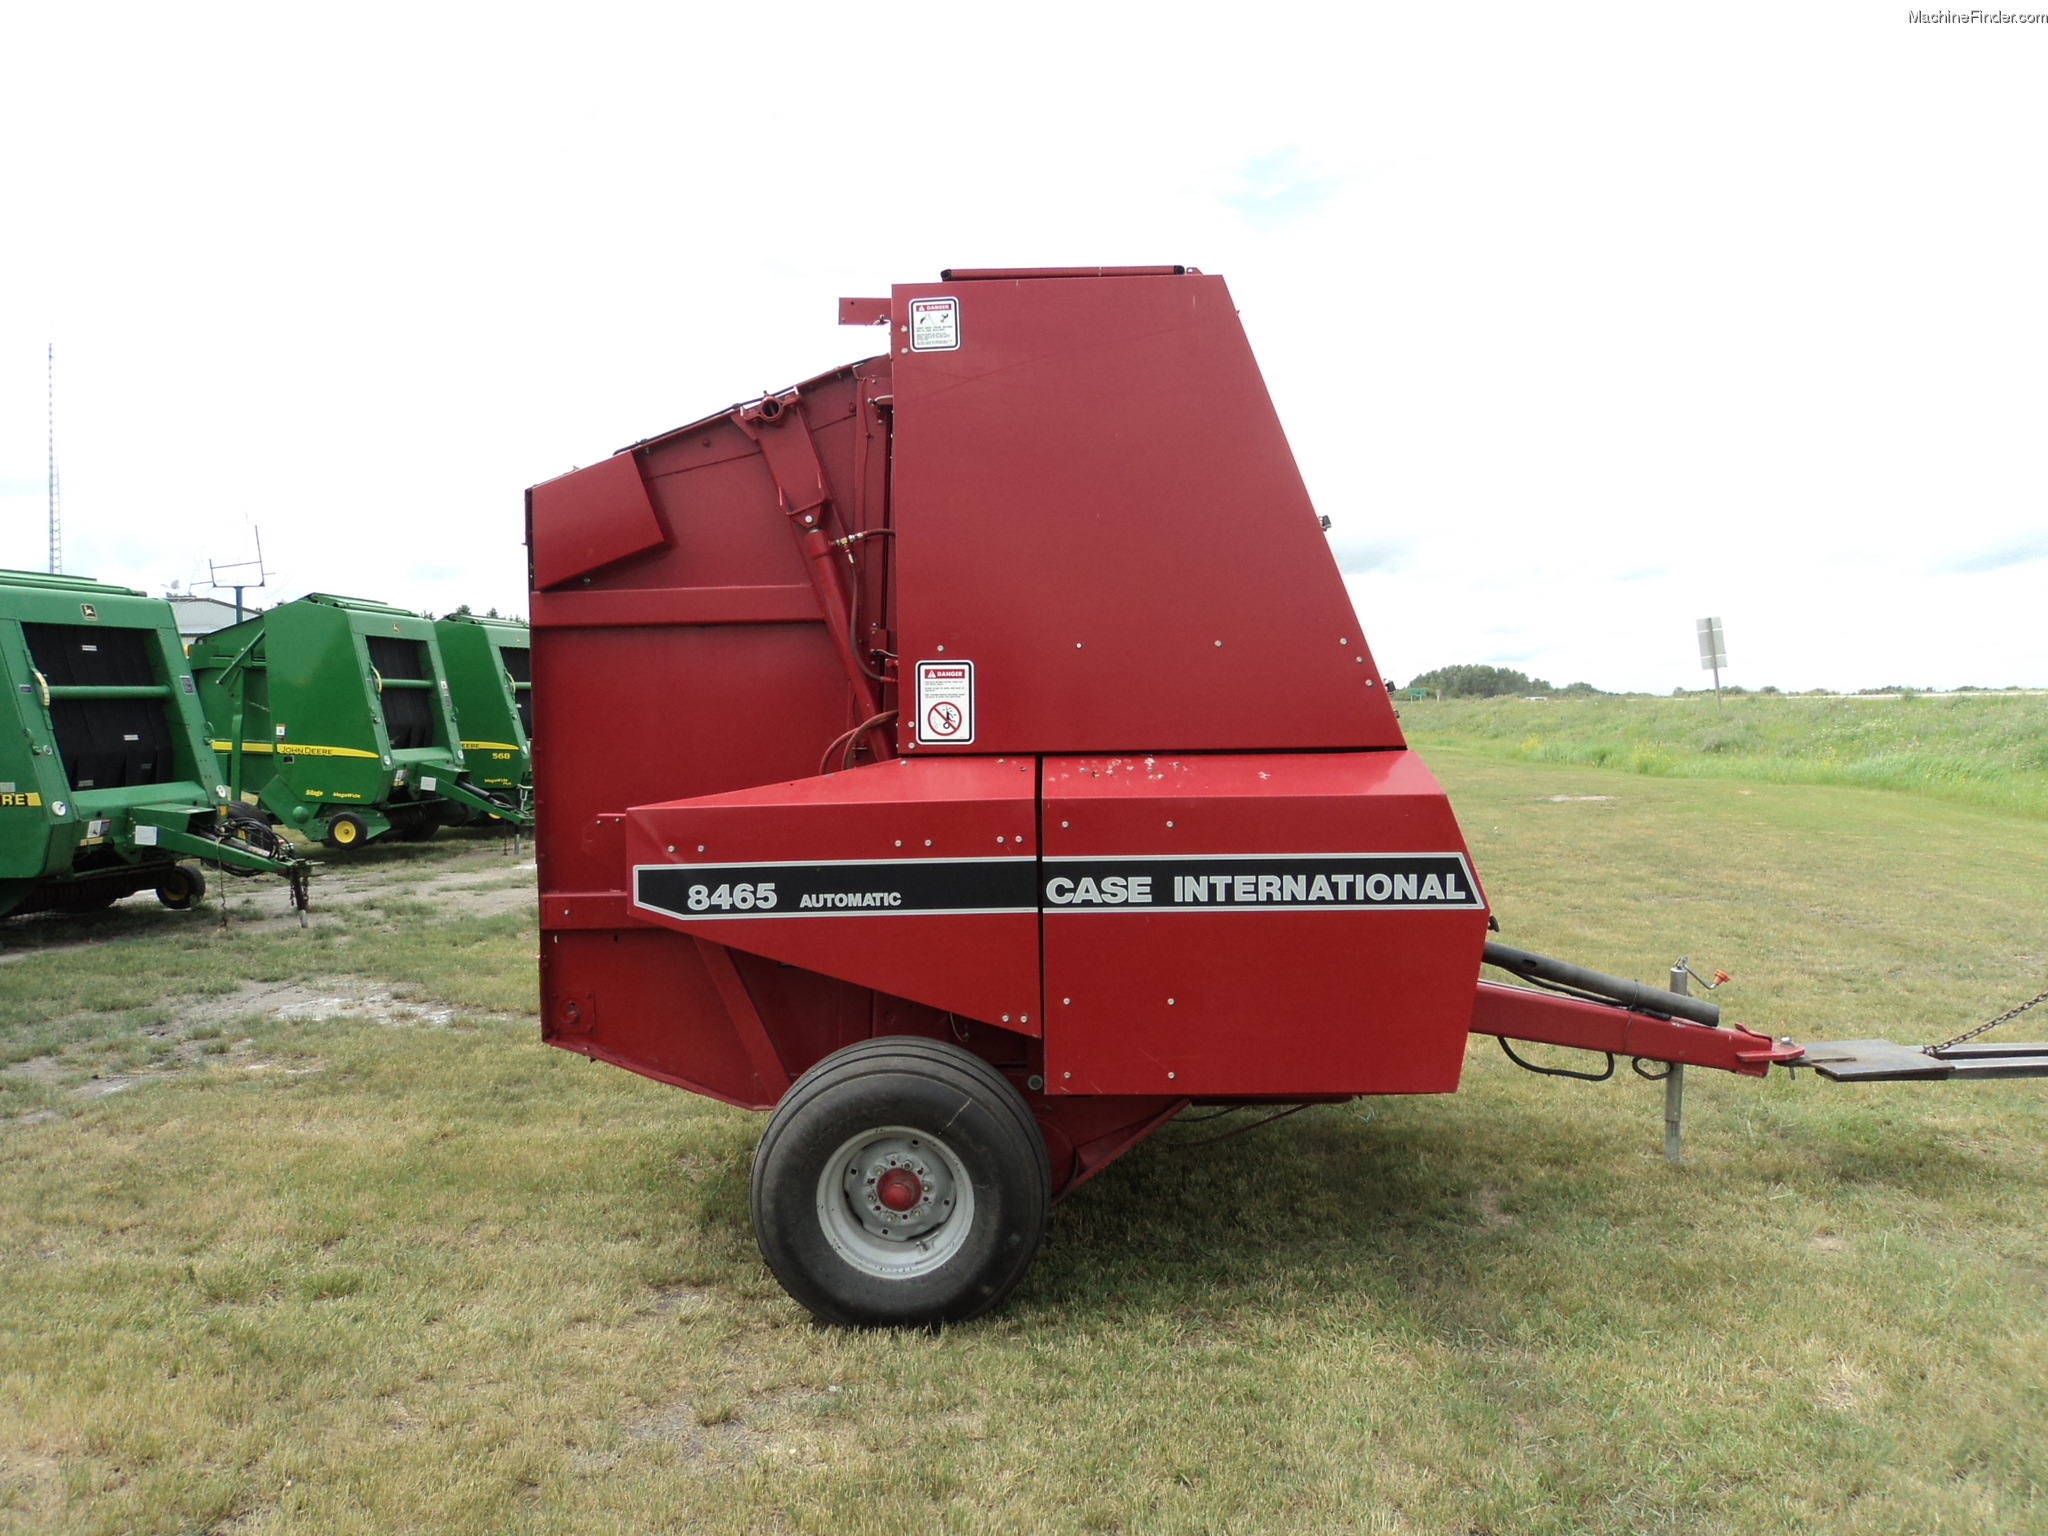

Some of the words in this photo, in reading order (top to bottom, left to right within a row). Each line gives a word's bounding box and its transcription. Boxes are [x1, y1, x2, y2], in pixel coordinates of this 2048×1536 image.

[281, 746, 304, 755] JOHN
[304, 746, 333, 756] DEERE
[492, 752, 511, 760] 568
[687, 882, 778, 911] 8465
[799, 891, 902, 908] AUTOMATIC
[1045, 876, 1152, 904] CASE
[1174, 873, 1466, 903] INTERNATIONAL
